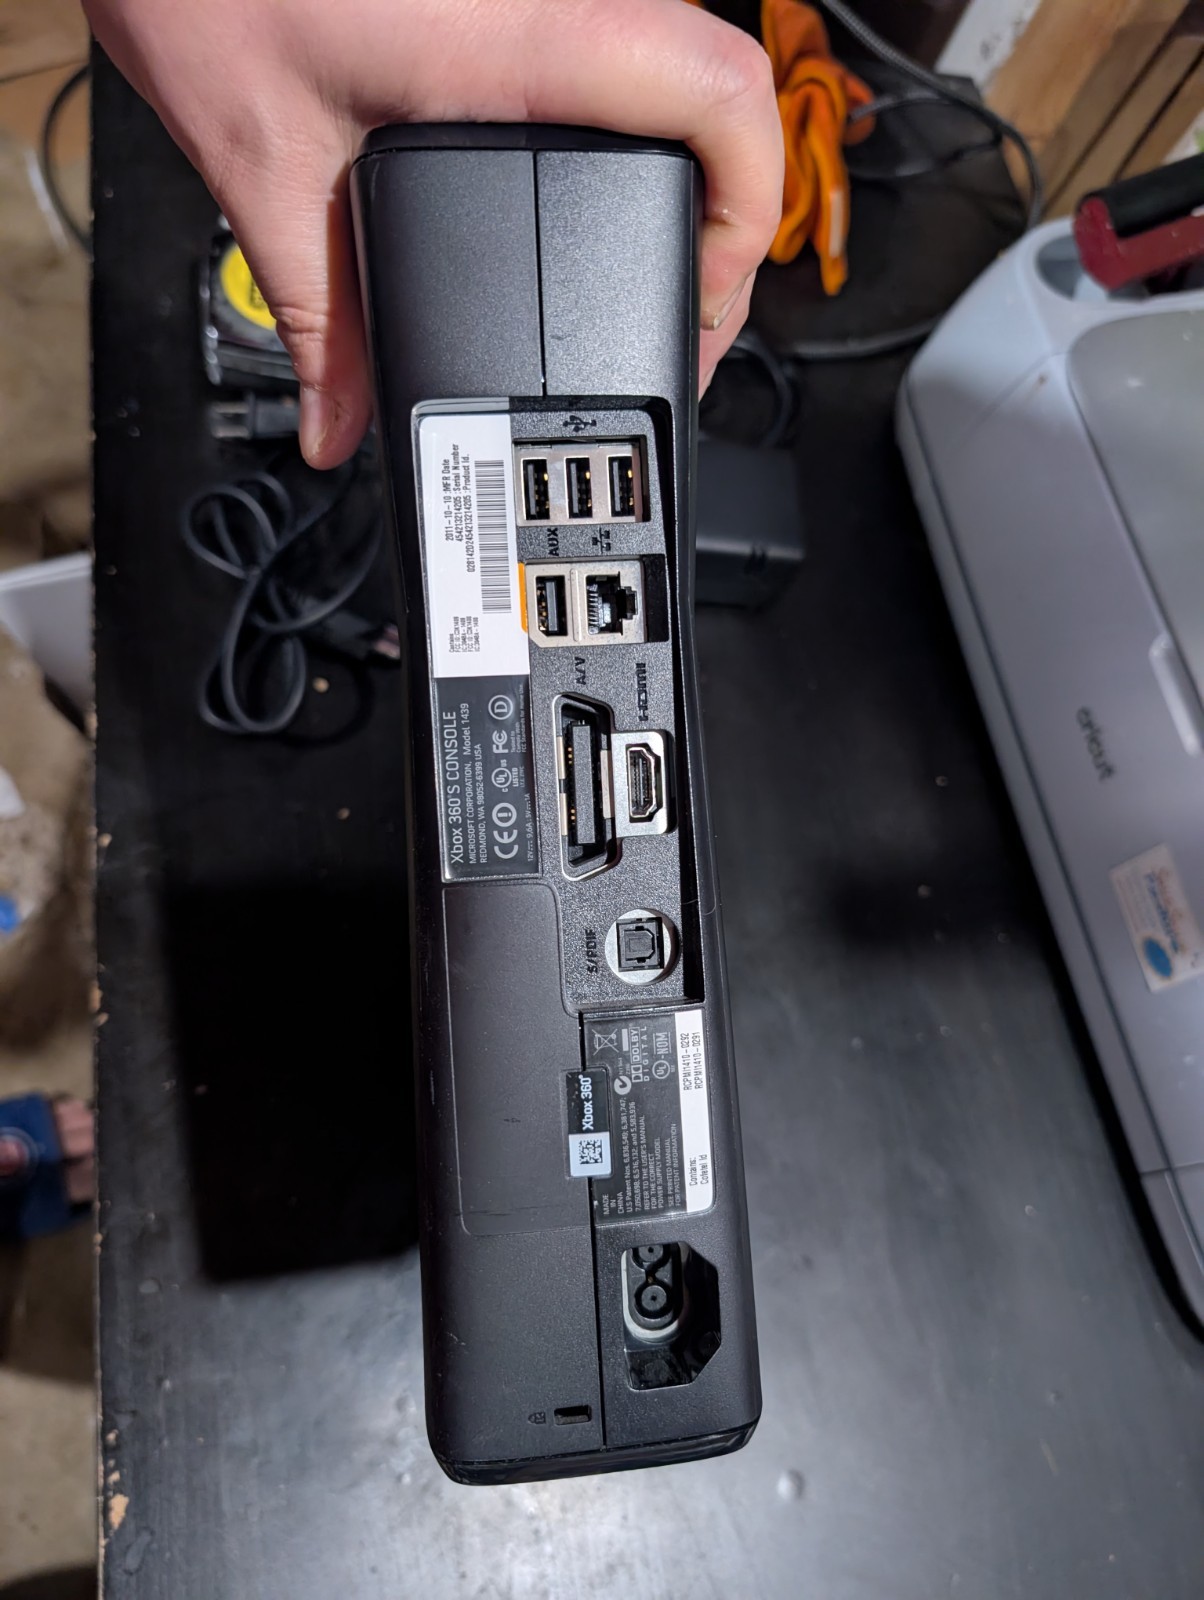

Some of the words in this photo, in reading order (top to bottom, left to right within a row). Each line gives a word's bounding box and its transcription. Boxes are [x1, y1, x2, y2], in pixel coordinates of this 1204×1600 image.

[442, 459, 450, 474] Date
[452, 444, 460, 470] Number
[453, 496, 464, 542] 454213214205
[547, 527, 559, 557] AUX
[575, 657, 586, 685] A/V
[635, 662, 648, 721] HDMI
[460, 703, 469, 724] 1439
[443, 712, 459, 780] CONSOLE
[463, 727, 471, 756] Model
[474, 743, 482, 760] USA
[464, 761, 475, 818] CORPORATION,
[475, 761, 484, 805] 98052-6399
[478, 806, 485, 820] WA
[450, 827, 464, 864] Xbox
[467, 819, 477, 864] MICROSOFT
[479, 820, 488, 863] REDMOND,
[493, 829, 519, 859] CE
[585, 928, 598, 974] S/PDIF
[630, 1029, 640, 1062] DOLBY
[641, 1026, 650, 1082] DIGITAL
[581, 1100, 594, 1131] Xbox
[638, 1114, 646, 1144] MANUAL
[664, 1138, 672, 1166] MANUAL
[671, 1123, 679, 1168] INFORMATION
[648, 1153, 656, 1182] CORRECT
[666, 1167, 674, 1194] PRINTED
[688, 1156, 698, 1186] Contains:
[642, 1180, 649, 1189] TO
[602, 1193, 610, 1215] MADE
[610, 1199, 616, 1208] IN
[616, 1192, 624, 1214] CHINA
[642, 1190, 650, 1210] REFER
[650, 1196, 658, 1209] FOR
[674, 1193, 682, 1206] FOR
